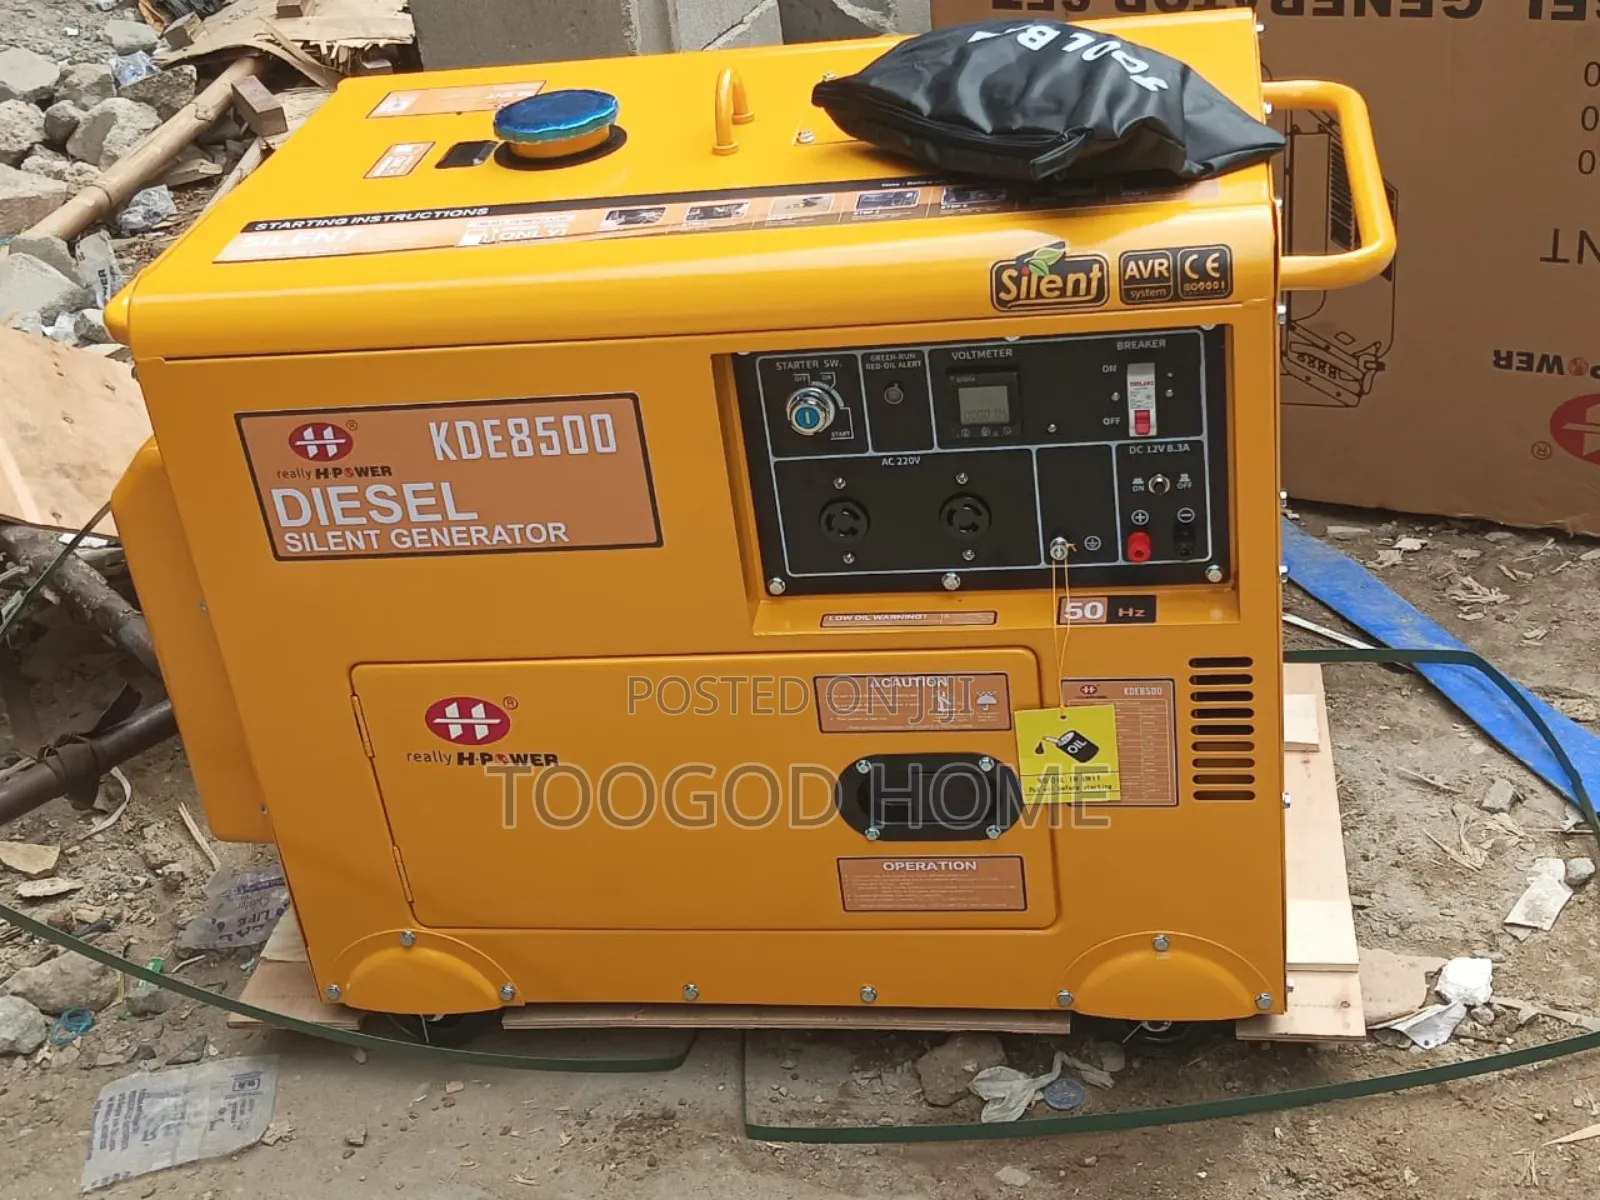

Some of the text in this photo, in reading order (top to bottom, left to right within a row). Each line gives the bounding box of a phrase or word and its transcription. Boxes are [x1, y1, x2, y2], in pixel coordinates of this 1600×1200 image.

[254, 217, 348, 232] STARTING
[350, 206, 490, 225] INSTRUCTIONS
[1124, 258, 1169, 281] AVR
[999, 262, 1102, 301] Silent
[1130, 288, 1166, 299] system
[1116, 339, 1167, 351] BREAKER
[951, 348, 1013, 361] VOLTMETER
[775, 360, 819, 371] STARTER
[1102, 365, 1117, 373] ON
[1103, 417, 1121, 426] OFF
[428, 413, 618, 462] KDE8500
[1129, 445, 1144, 454] DC
[1147, 444, 1165, 453] 12V
[881, 456, 921, 466] AC 220V
[270, 480, 479, 528] DIESEL
[284, 523, 570, 553] SILENT GENERATOR
[1063, 601, 1145, 621] 50 Hz
[880, 677, 949, 689] CAUTION
[1067, 738, 1088, 755] OIL
[406, 751, 452, 766] really
[883, 861, 977, 871] OPERATION
